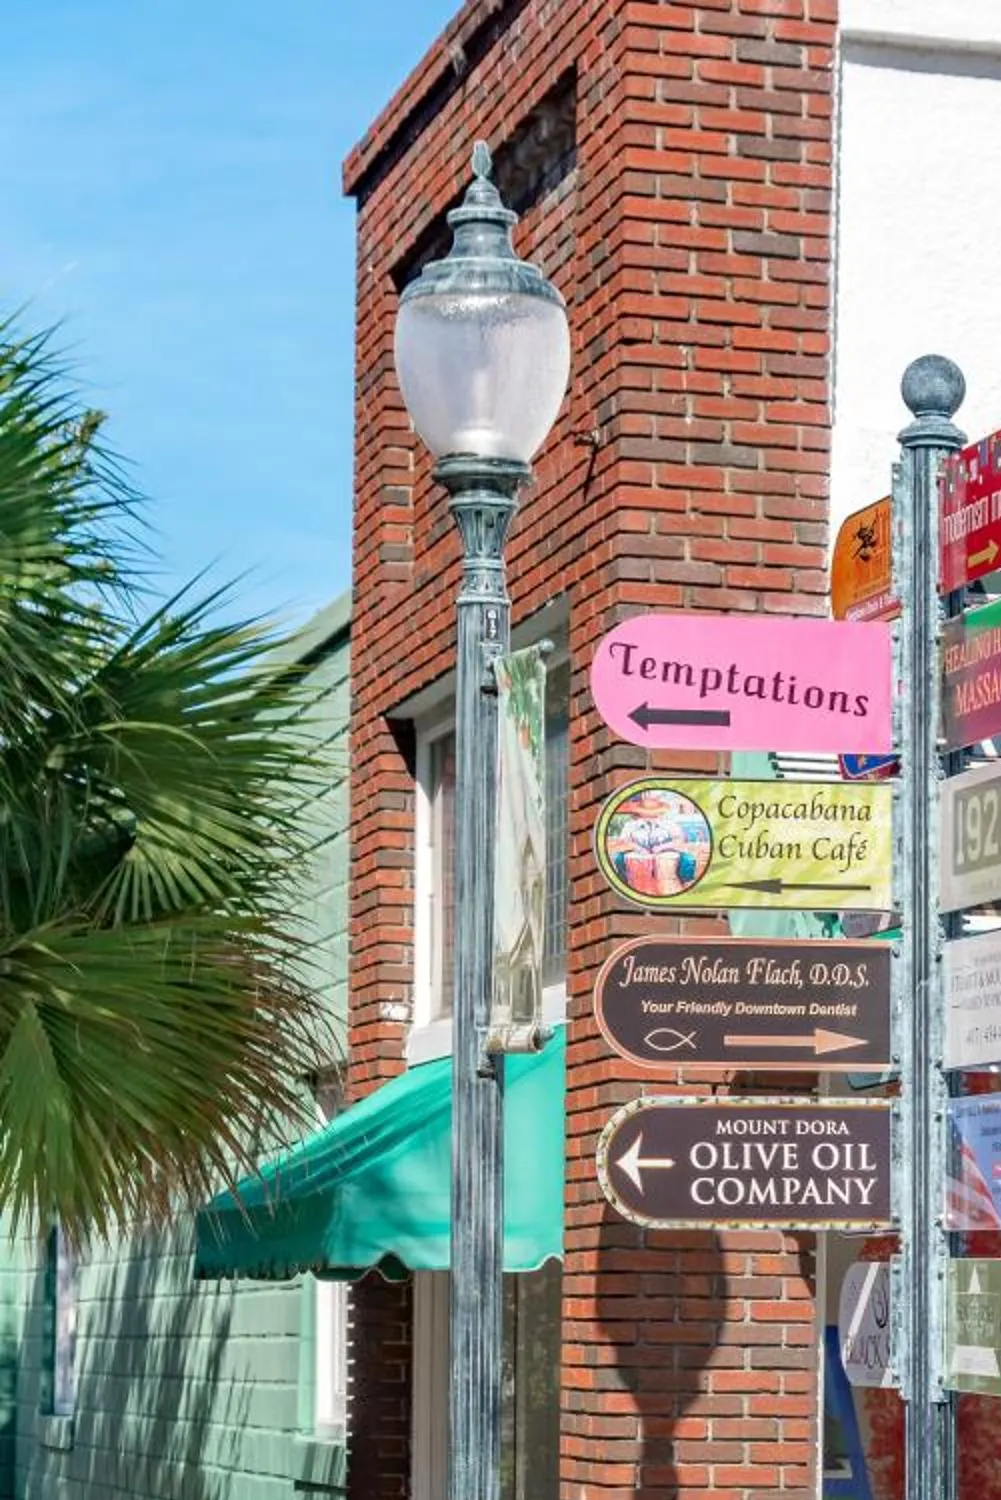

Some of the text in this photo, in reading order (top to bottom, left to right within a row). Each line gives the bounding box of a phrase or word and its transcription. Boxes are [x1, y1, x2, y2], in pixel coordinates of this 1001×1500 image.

[609, 641, 870, 717] Temptations
[717, 791, 873, 830] Copacabana
[718, 830, 868, 872] Cuban Café
[619, 955, 870, 989] James Nolan Flach, D.D.S.
[641, 1000, 858, 1017] Your Friendly Downtown Dentist
[716, 1119, 850, 1136] MOUNT DORA
[689, 1141, 878, 1172] OLIVE OIL
[690, 1176, 879, 1206] COMPANY
